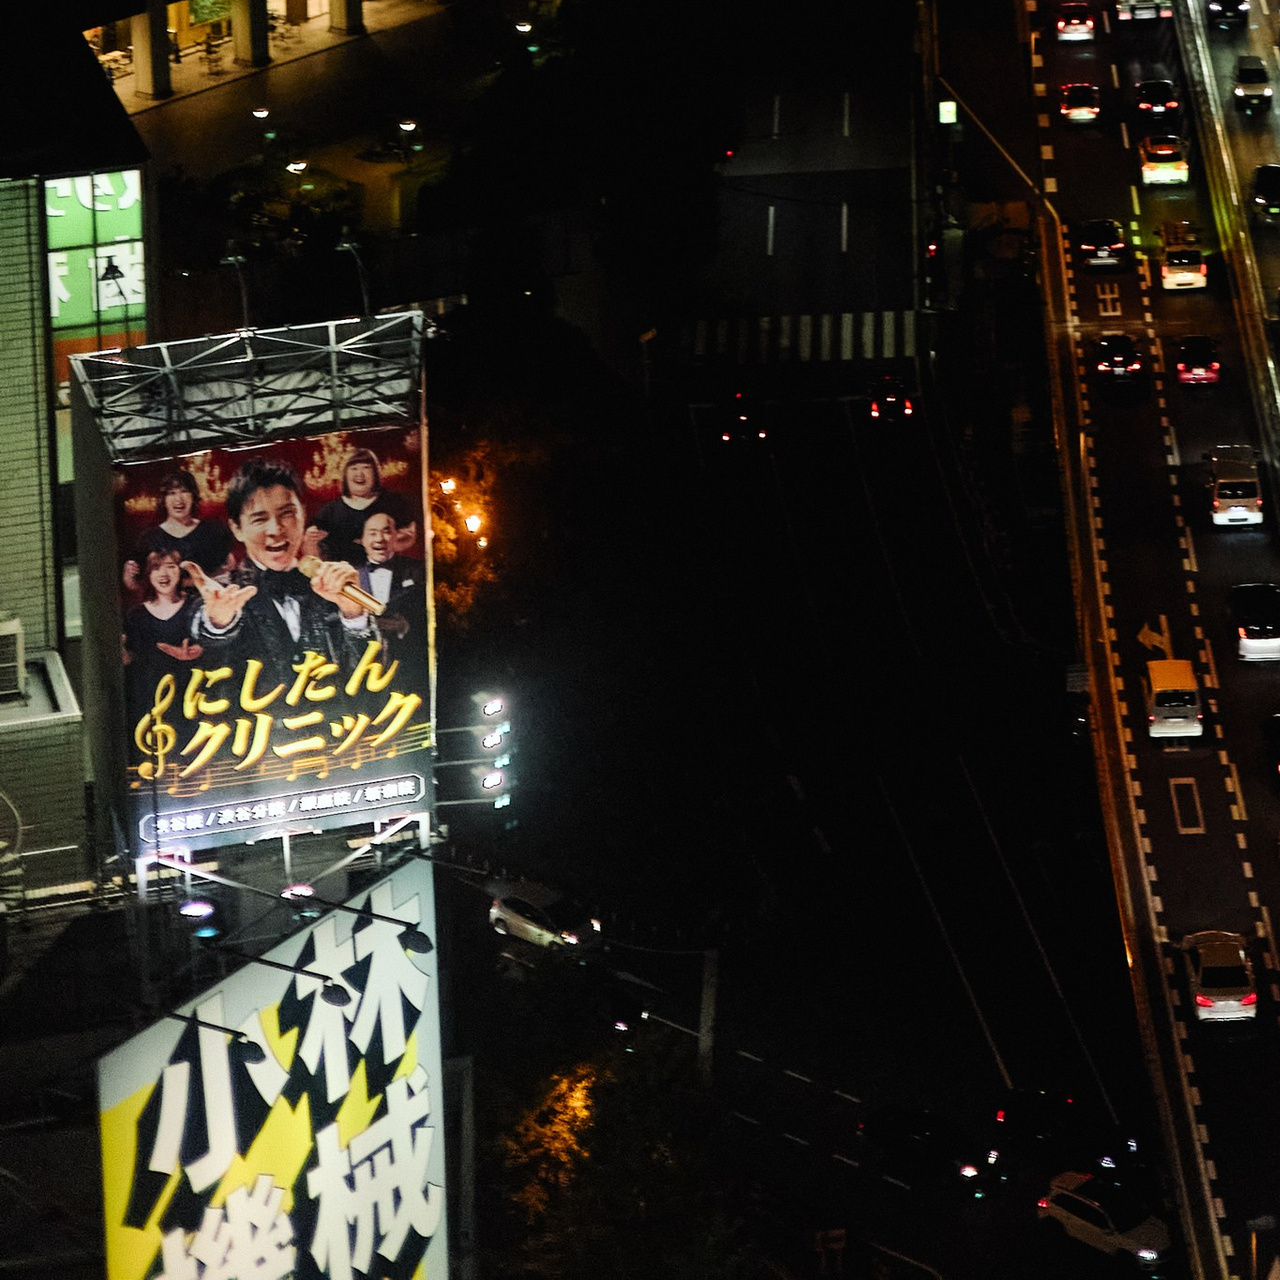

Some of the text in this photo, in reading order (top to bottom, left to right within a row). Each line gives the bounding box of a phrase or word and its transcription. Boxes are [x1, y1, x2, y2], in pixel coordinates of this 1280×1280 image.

[183, 641, 399, 720] にしたん
[179, 692, 422, 778] クリニック
[149, 878, 430, 1194] 小林
